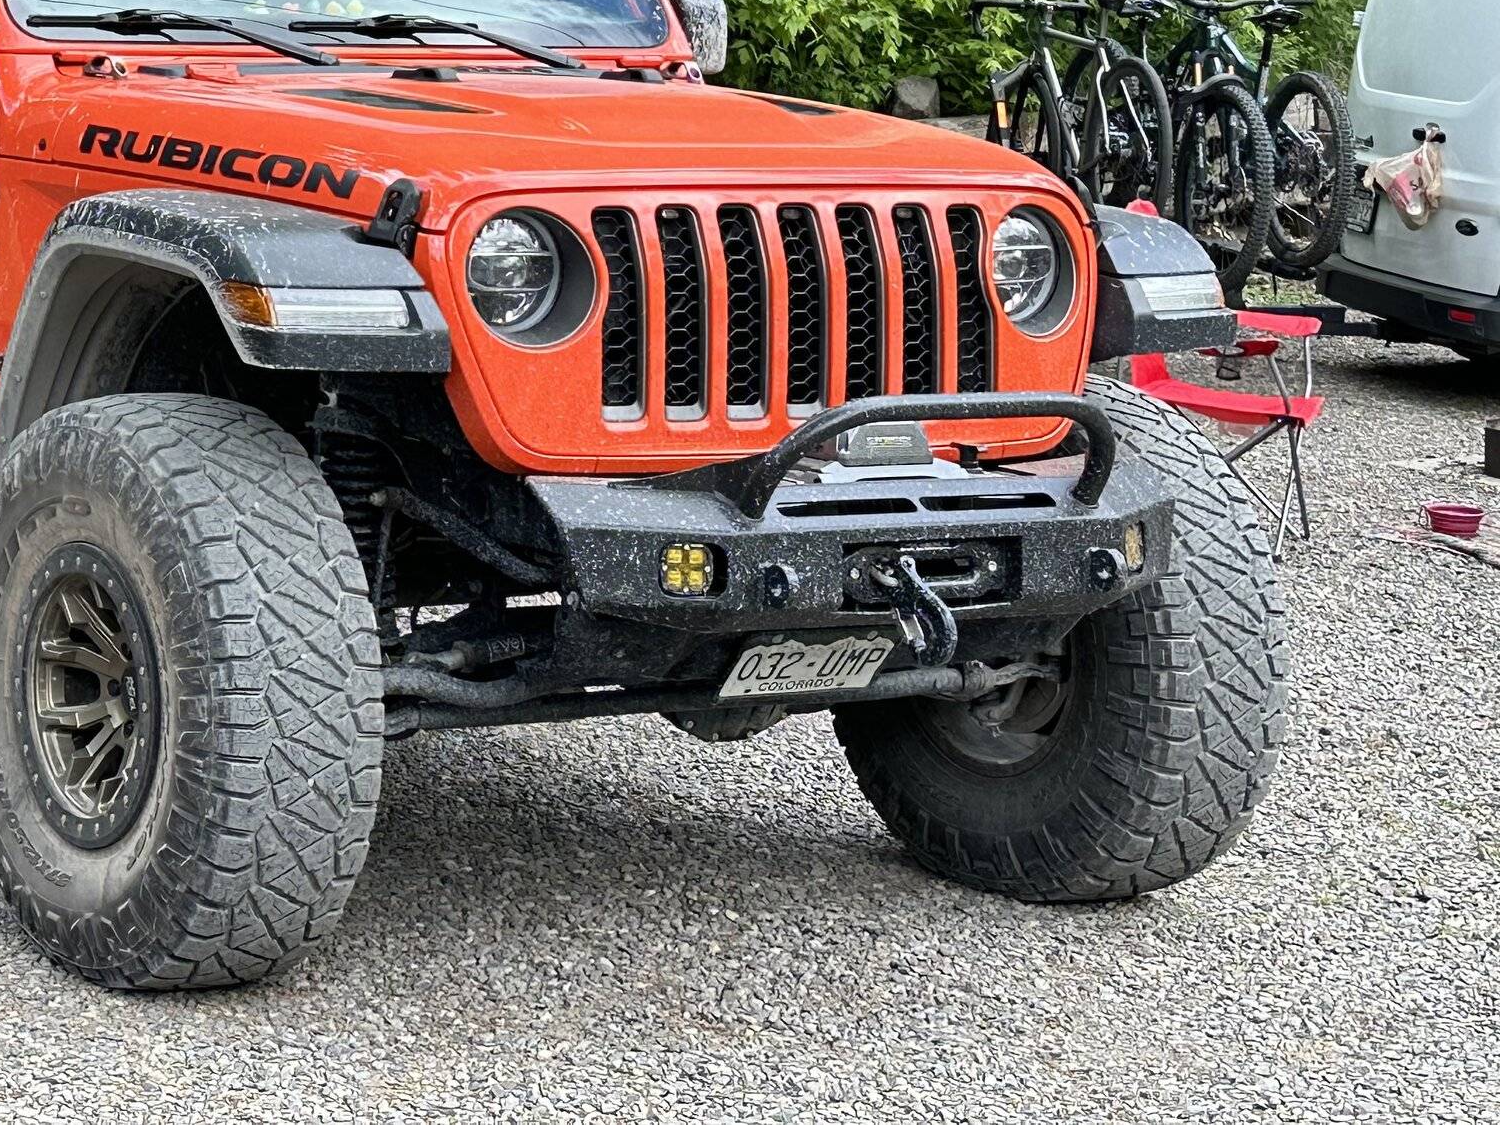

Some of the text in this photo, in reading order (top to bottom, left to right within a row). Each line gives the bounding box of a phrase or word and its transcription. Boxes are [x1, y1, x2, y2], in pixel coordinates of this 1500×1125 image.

[79, 124, 360, 200] RUBICON
[737, 647, 886, 681] 032-UMP
[758, 678, 834, 692] COLORADO
